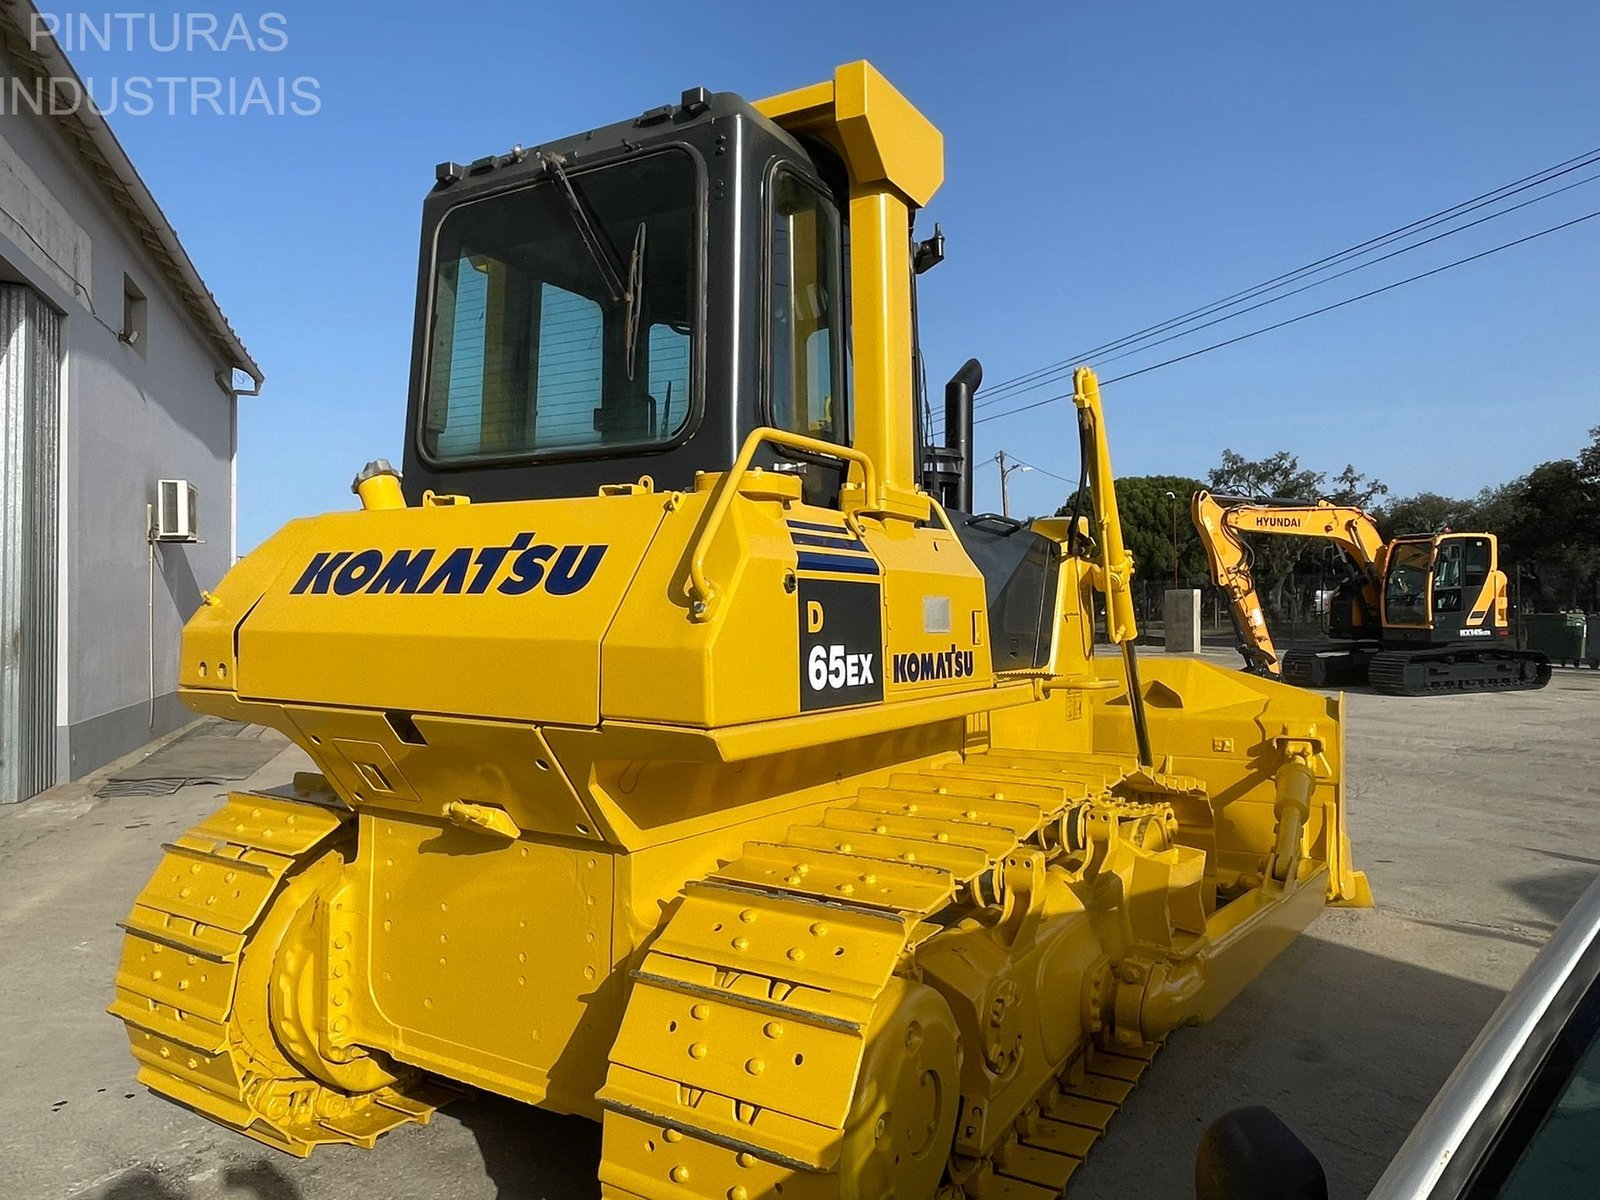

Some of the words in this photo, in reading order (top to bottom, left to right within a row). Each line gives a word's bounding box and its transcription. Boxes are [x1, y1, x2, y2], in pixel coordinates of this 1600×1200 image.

[1256, 517, 1301, 527] HYUNDAI
[289, 532, 609, 596] KOMATSU
[807, 600, 824, 633] D
[808, 644, 875, 691] 65EX
[893, 643, 974, 684] KOMATSU
